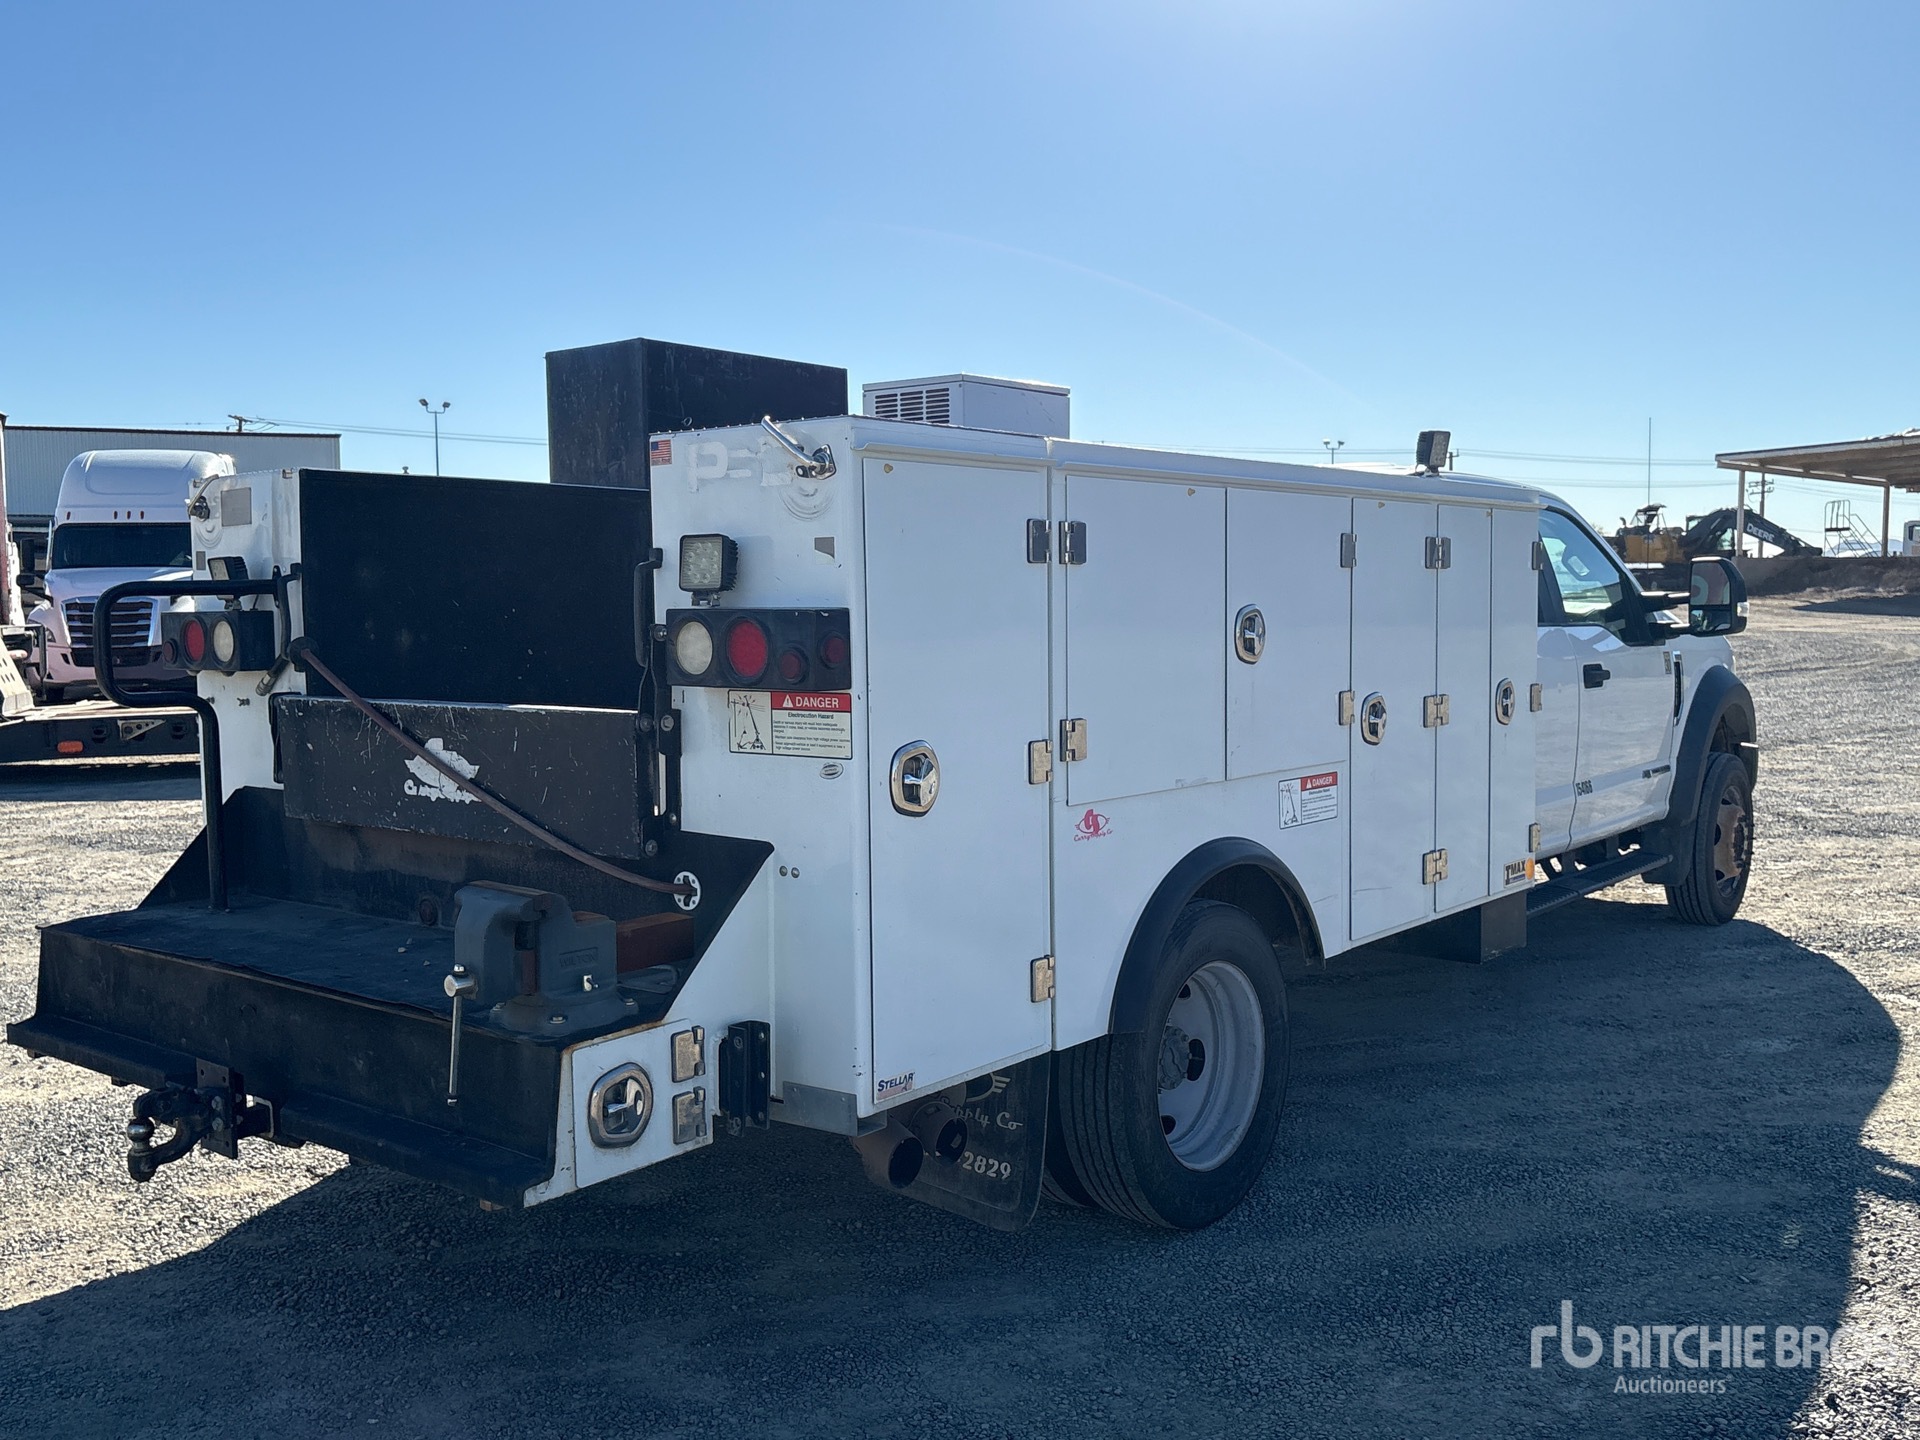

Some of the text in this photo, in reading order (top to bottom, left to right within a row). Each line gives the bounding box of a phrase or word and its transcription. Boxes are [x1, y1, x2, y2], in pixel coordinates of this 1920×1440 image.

[1746, 522, 1775, 542] DEERE
[795, 696, 839, 709] DANGER
[1312, 776, 1333, 787] DANGER
[877, 1072, 915, 1092] STELLAR
[996, 1111, 1024, 1130] Co
[962, 1151, 1012, 1180] 2829
